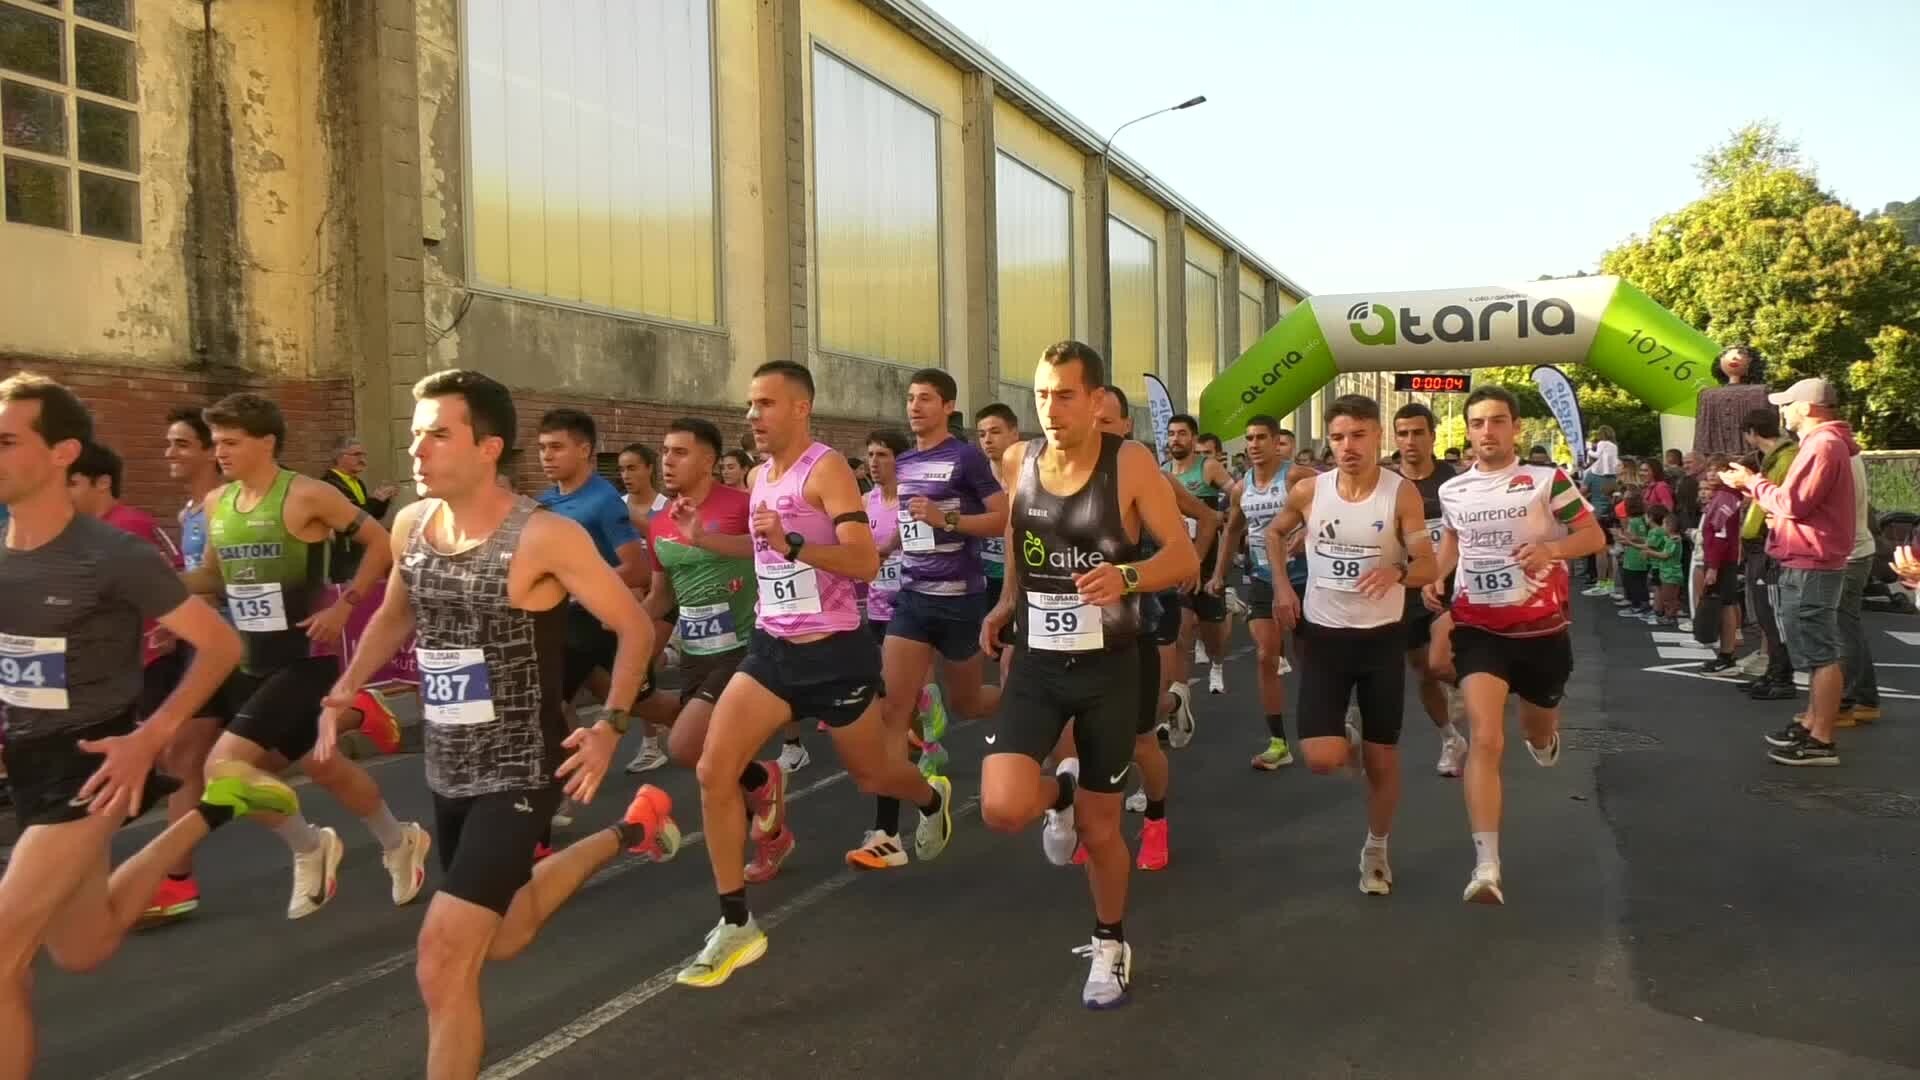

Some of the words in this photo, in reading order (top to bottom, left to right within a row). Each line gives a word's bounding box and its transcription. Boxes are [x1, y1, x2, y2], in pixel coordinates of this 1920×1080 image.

[1349, 298, 1575, 346] ataria
[1627, 329, 1697, 381] 107.6
[1411, 377, 1463, 389] 0:00:04
[903, 525, 918, 538] 21
[1049, 547, 1105, 569] aike
[1333, 560, 1360, 577] 98
[774, 580, 796, 600] 61
[1474, 573, 1512, 590] 183
[237, 600, 271, 617] 135
[687, 619, 723, 636] 274
[1045, 612, 1077, 632] 59
[425, 675, 470, 700] 287
